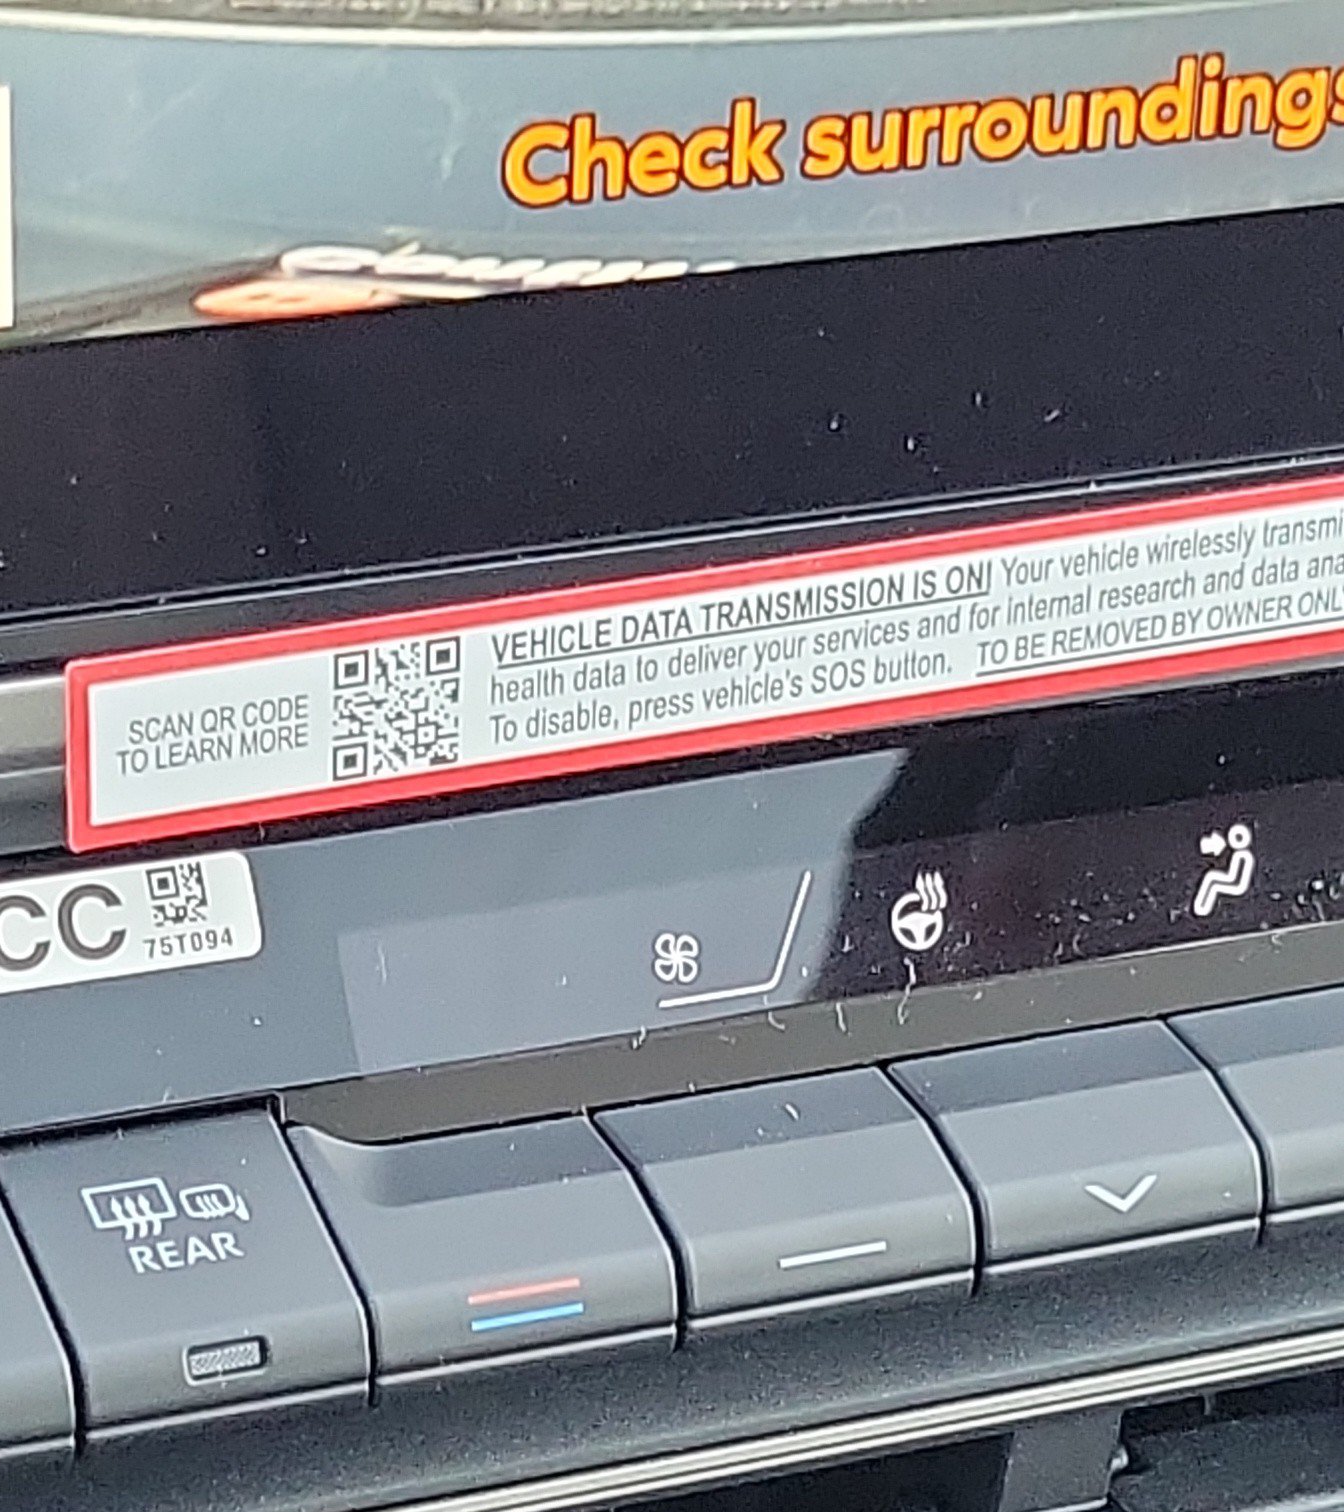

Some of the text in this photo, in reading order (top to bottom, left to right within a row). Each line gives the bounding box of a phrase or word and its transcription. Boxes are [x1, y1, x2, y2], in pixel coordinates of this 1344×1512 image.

[501, 98, 785, 207] Check
[491, 662, 565, 705] health
[573, 660, 625, 693] data
[636, 654, 657, 682] to
[668, 637, 747, 679] deliver
[754, 634, 806, 670] your
[813, 621, 910, 655] services
[917, 606, 961, 639] and
[968, 600, 1001, 633] for
[1005, 584, 1091, 625] internal
[1097, 574, 1196, 611] research
[1203, 562, 1245, 597] and
[1252, 552, 1299, 588] data
[492, 617, 612, 663] VEHICLE
[622, 608, 691, 644] DATA
[703, 574, 904, 634] TRANSMISSION
[914, 569, 936, 601] IS
[1000, 556, 1054, 588] Your
[1060, 538, 1139, 581] vehicle
[1146, 522, 1255, 563] wirelessly
[977, 640, 1009, 666] TO
[1014, 635, 1046, 662] BE
[1051, 610, 1166, 656] REMOVED
[1171, 606, 1203, 637] BY
[1207, 593, 1293, 633] OWNER
[128, 695, 309, 744] SCAN QR CODE
[491, 651, 952, 744] To disable, press vehicle's SOS button.
[117, 724, 309, 776] TO LEARN MORE
[142, 927, 234, 959] 75T094
[129, 1232, 245, 1274] REAR
